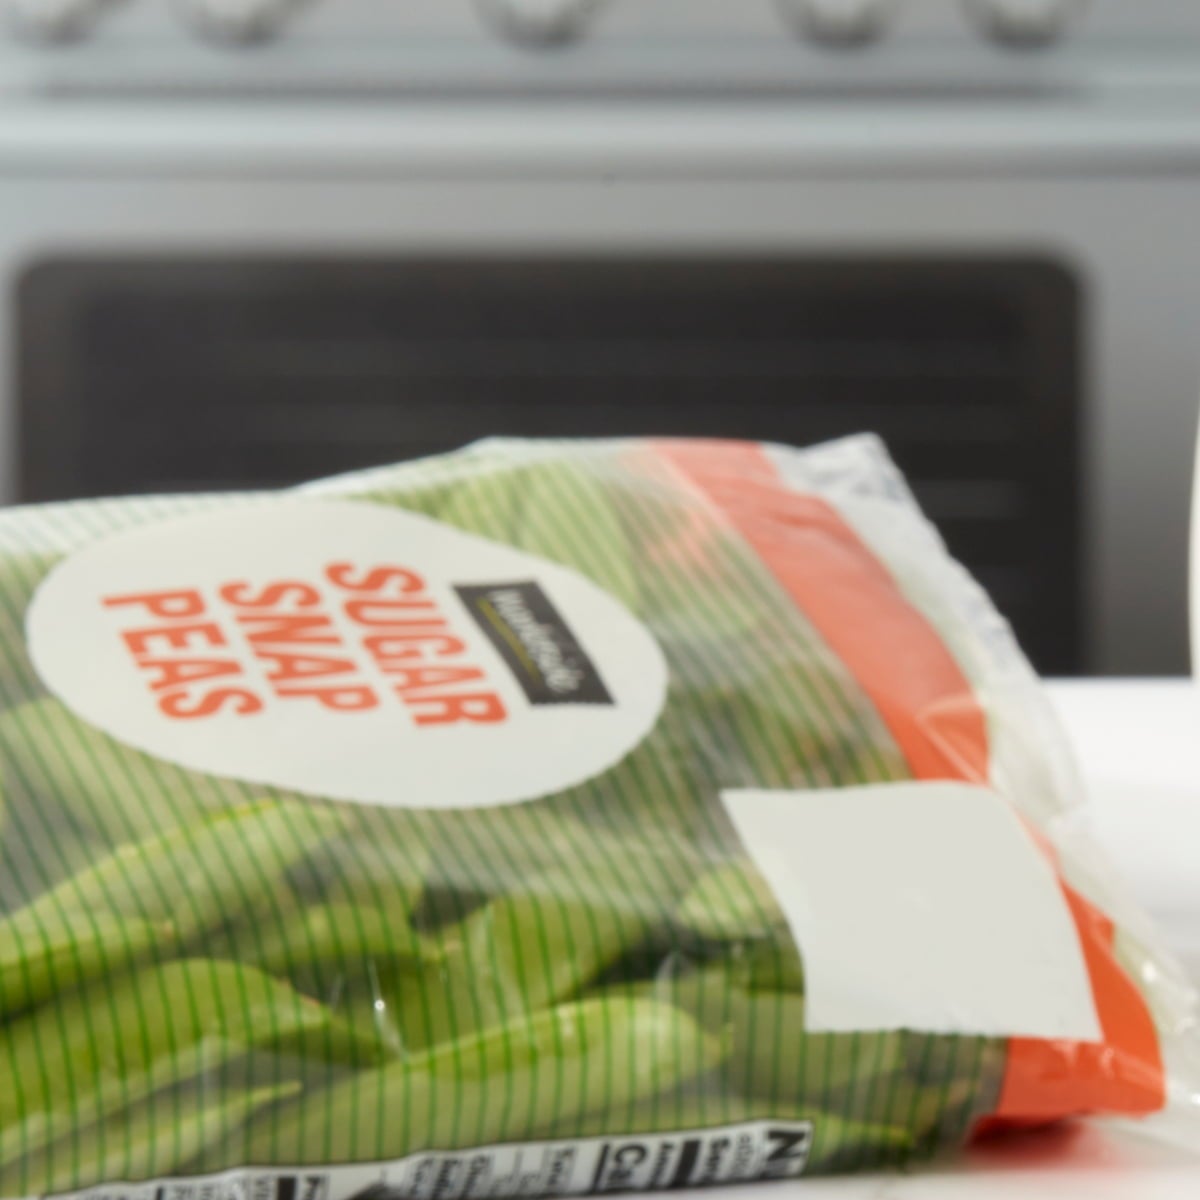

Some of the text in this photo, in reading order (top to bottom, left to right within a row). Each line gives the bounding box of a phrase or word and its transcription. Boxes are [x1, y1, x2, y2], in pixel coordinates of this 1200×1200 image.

[102, 589, 264, 720] PEAS
[218, 580, 380, 714] SNAP
[324, 562, 508, 728] SUGAR
